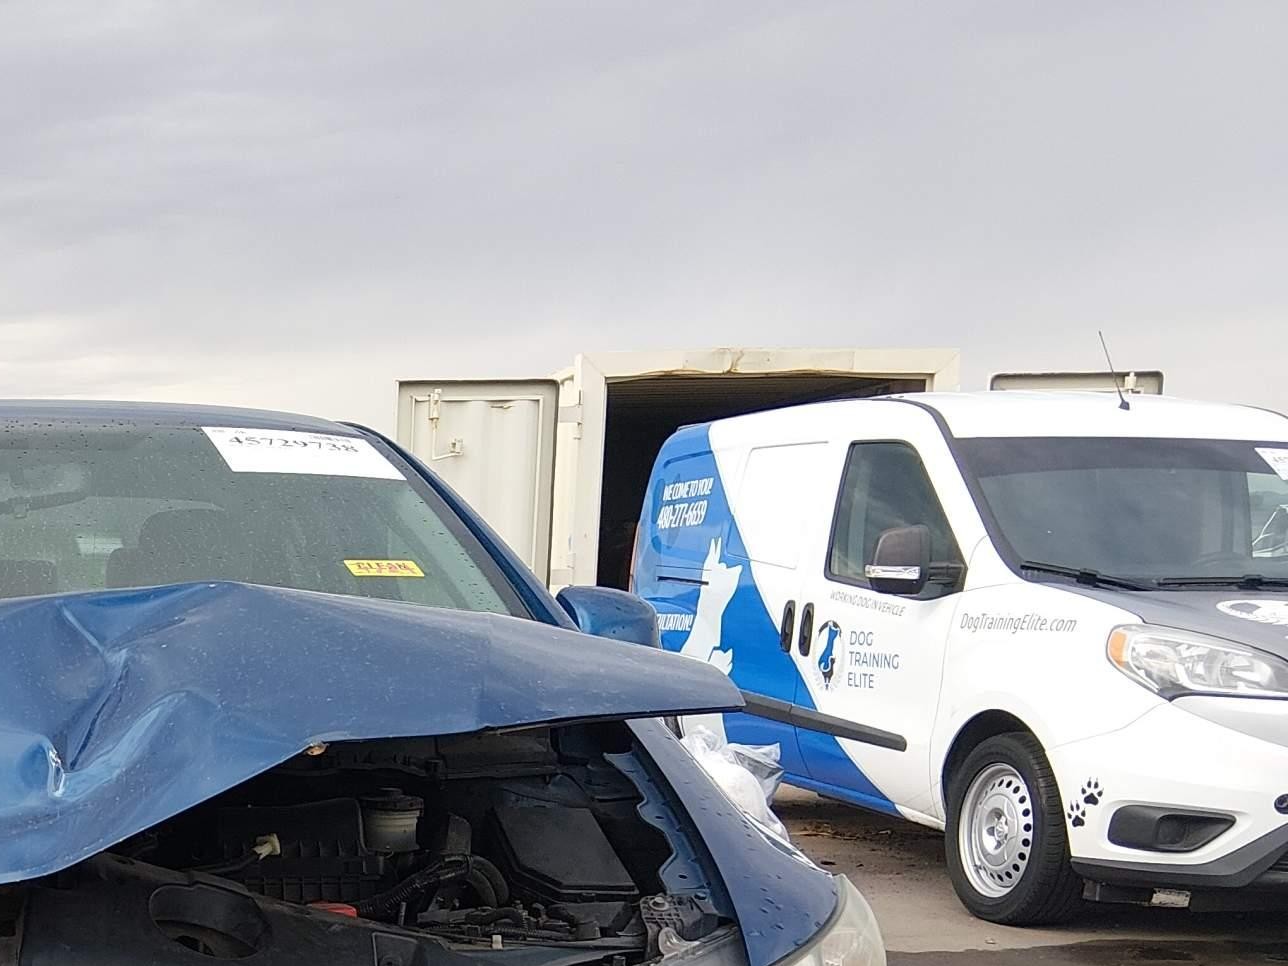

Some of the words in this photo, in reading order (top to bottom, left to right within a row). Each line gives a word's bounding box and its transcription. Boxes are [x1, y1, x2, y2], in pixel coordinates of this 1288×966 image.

[228, 435, 360, 453] 45729738
[672, 481, 691, 500] COME
[689, 479, 699, 497] TO
[959, 612, 1078, 634] DogTrainingElite.com
[849, 630, 874, 647] DOG
[848, 650, 900, 670] TRAINING
[847, 671, 875, 689] ELITE
